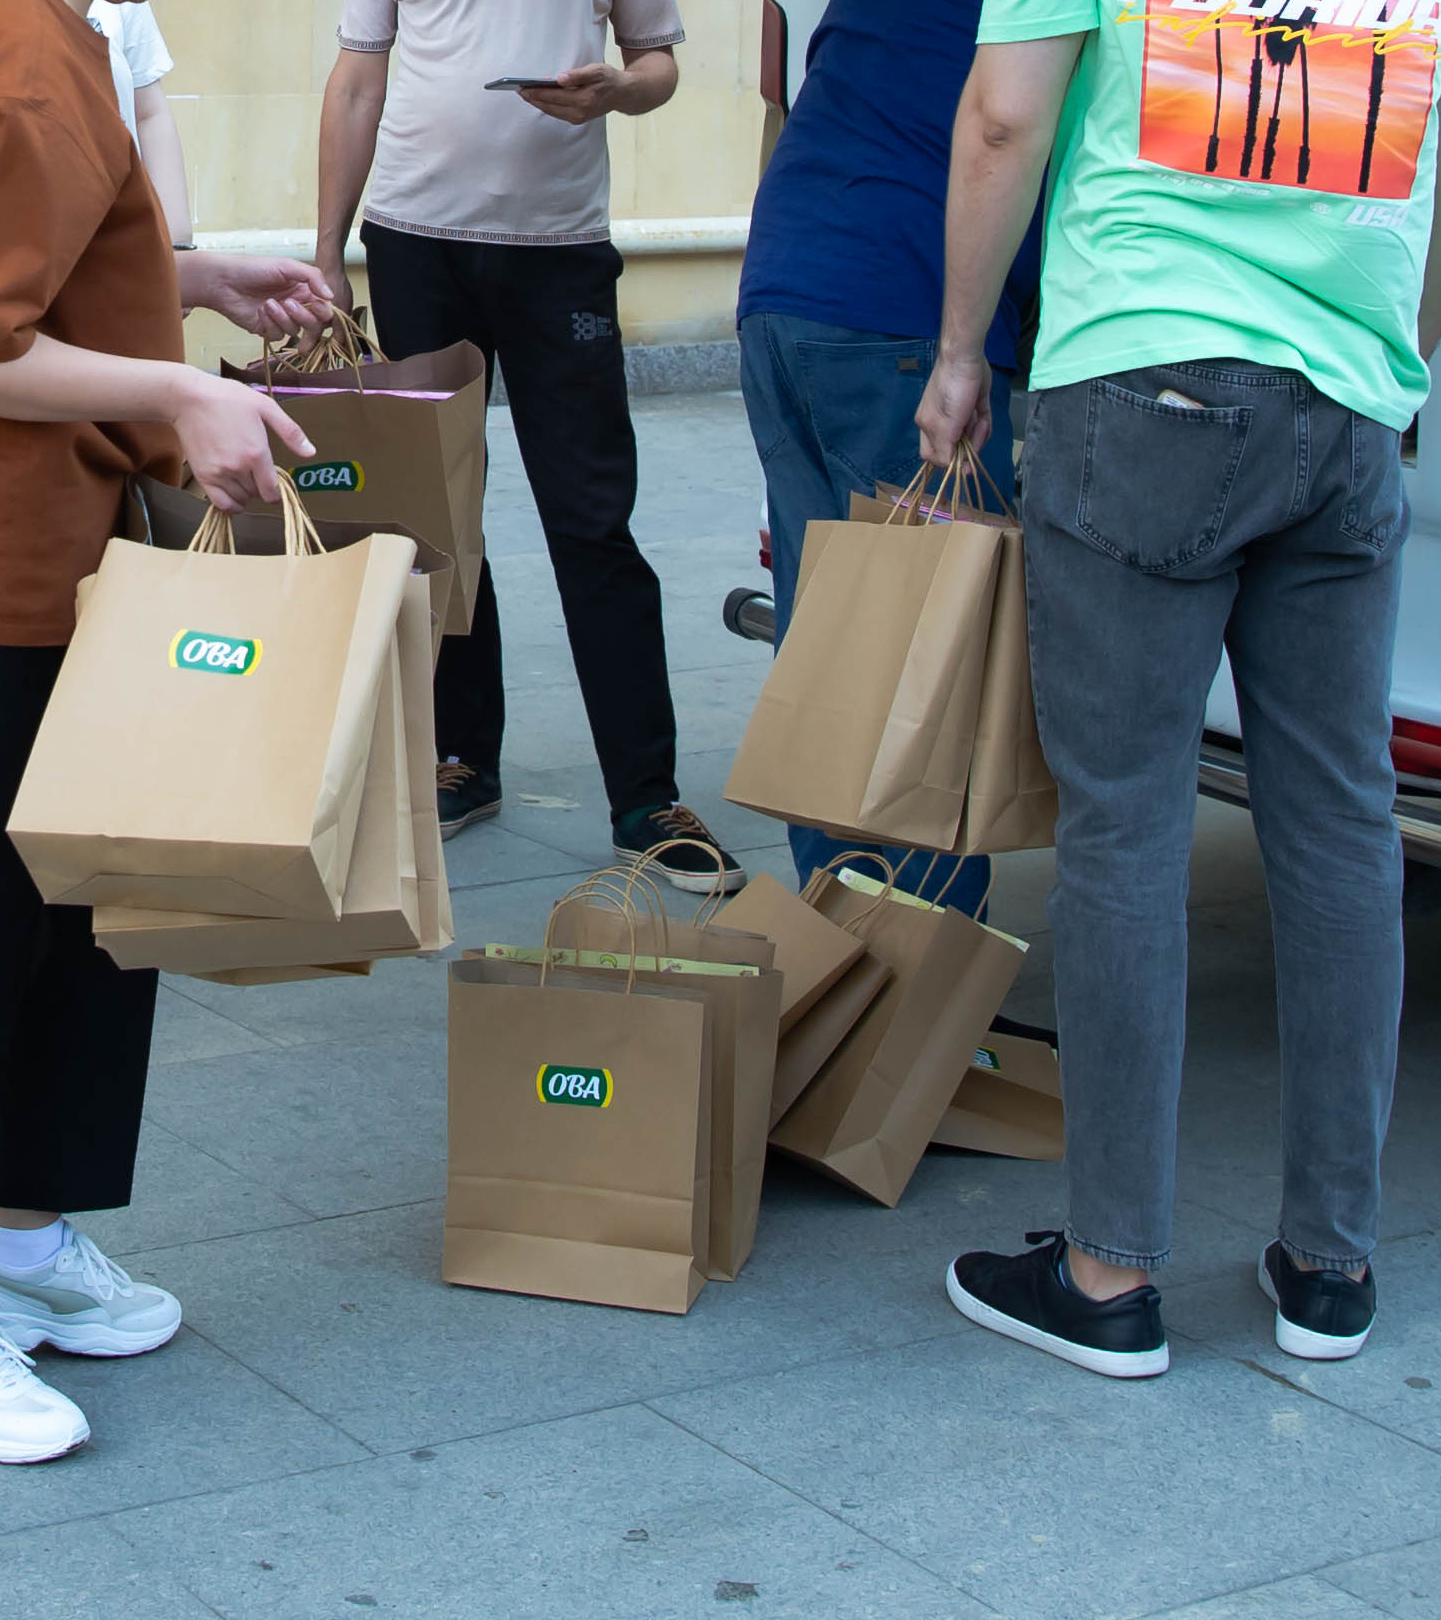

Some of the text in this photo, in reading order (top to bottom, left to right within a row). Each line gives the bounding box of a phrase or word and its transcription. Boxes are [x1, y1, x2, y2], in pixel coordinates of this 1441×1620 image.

[1345, 203, 1410, 229] USA
[298, 467, 352, 486] OBA
[183, 638, 249, 669] OBA
[548, 1073, 601, 1100] OBA
